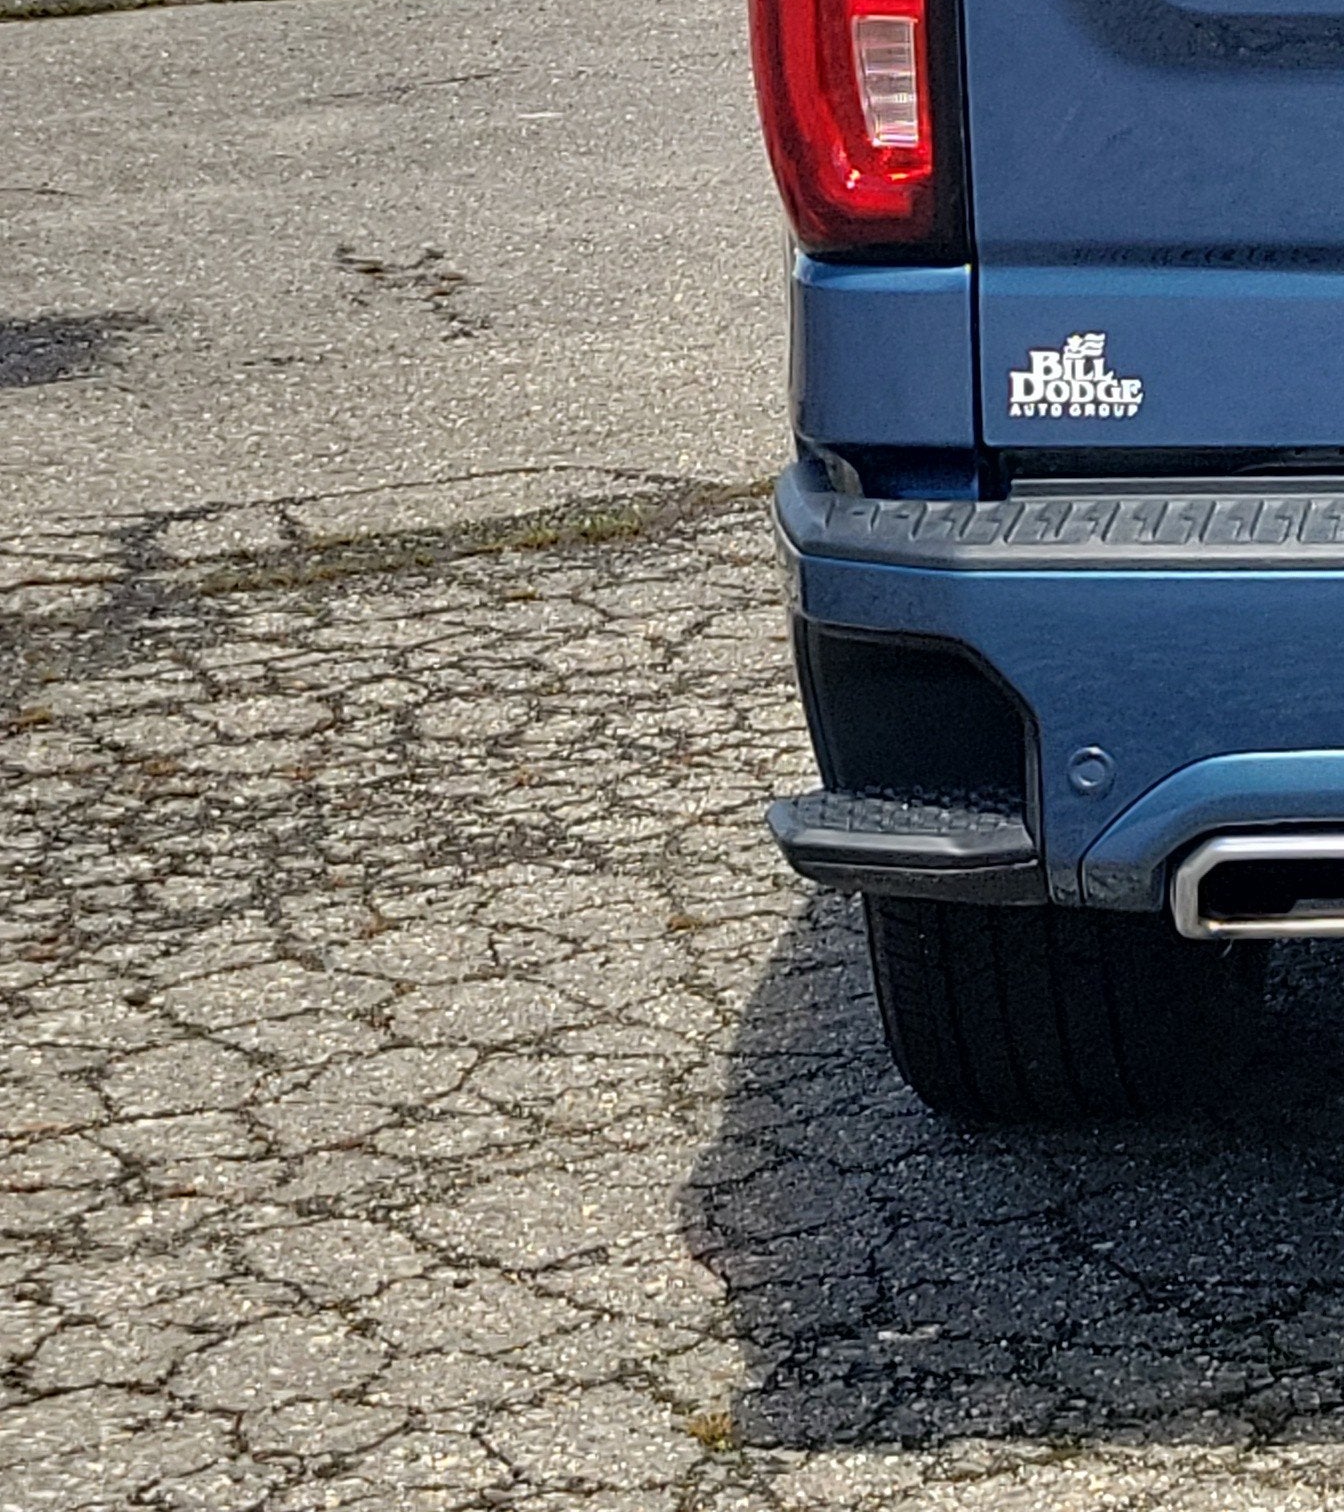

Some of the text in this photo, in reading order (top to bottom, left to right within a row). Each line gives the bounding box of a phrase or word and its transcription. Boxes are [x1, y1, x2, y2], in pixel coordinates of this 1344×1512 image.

[1029, 350, 1114, 382] BILL
[1009, 370, 1144, 405] DODGE
[1009, 403, 1139, 418] AUTO GROUP
